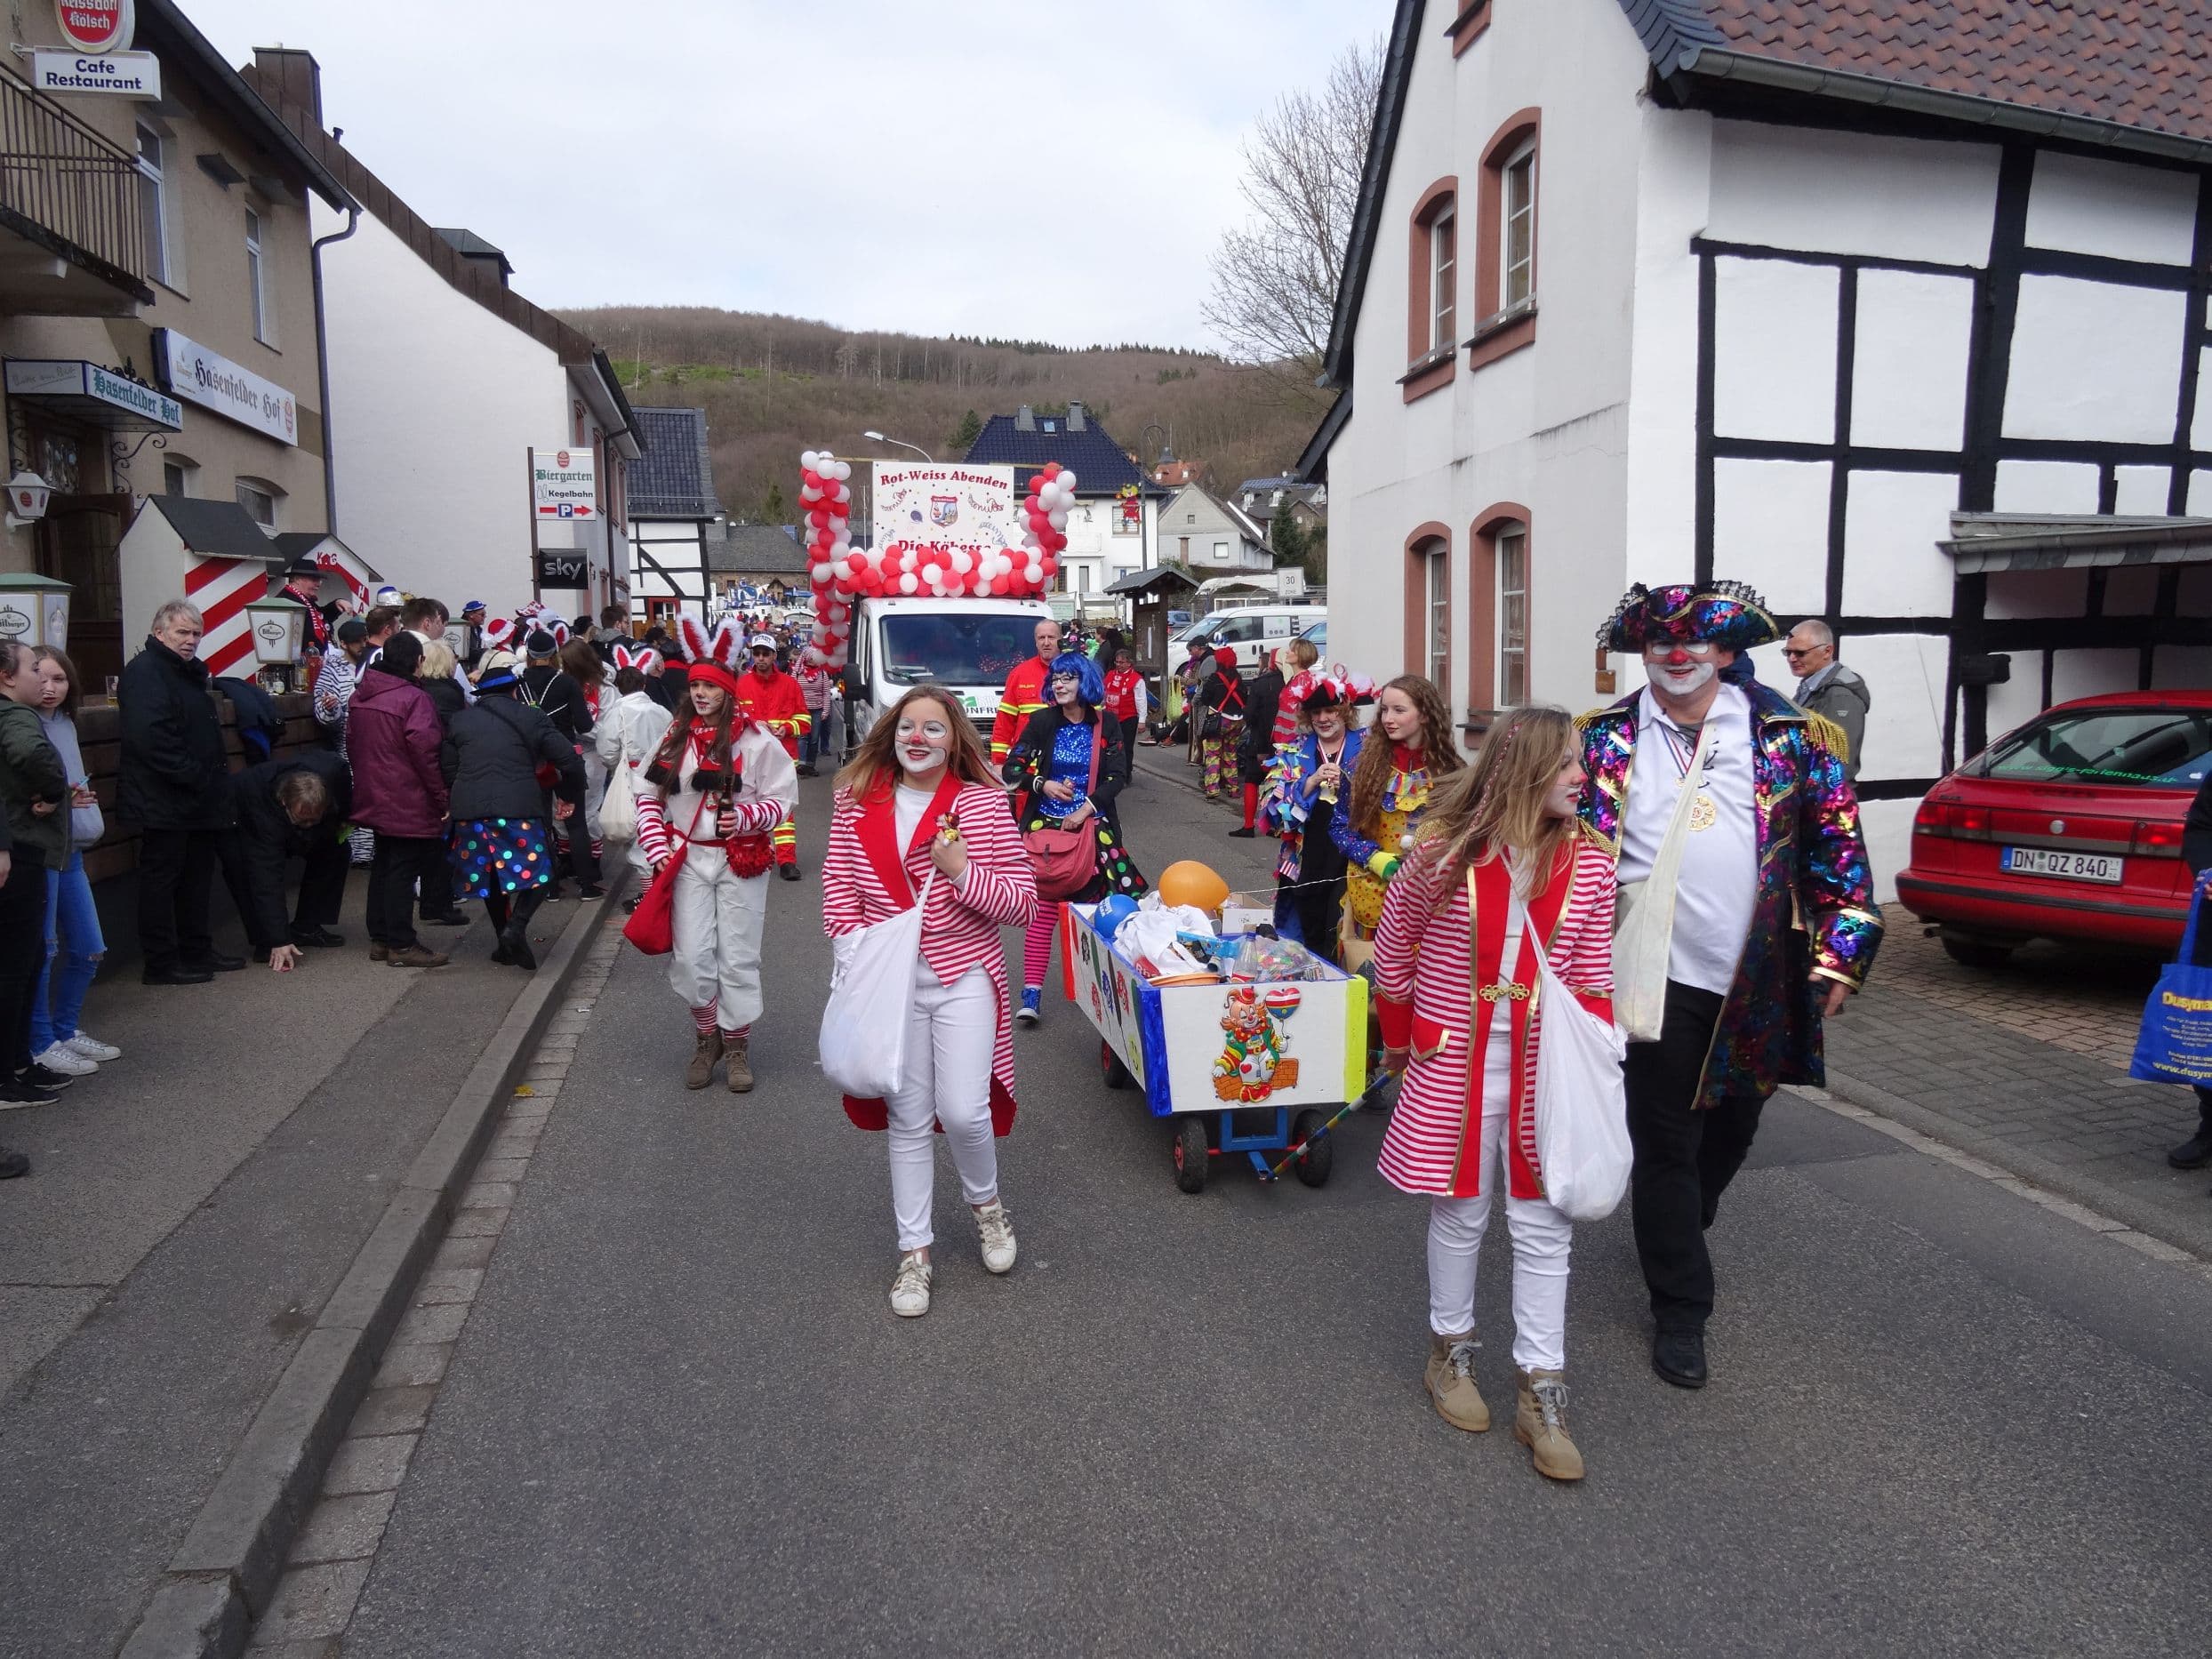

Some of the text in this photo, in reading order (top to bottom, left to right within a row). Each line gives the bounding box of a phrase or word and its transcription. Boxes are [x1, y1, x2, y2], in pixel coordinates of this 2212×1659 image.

[69, 11, 110, 30] Kölsch
[76, 59, 116, 74] Cafe
[46, 72, 142, 90] Restaurant
[93, 368, 157, 414] Hasenfelder
[160, 397, 180, 423] Hof
[195, 357, 258, 410] Hasenfelder
[262, 393, 281, 427] Hof
[535, 469, 593, 483] Biergarten
[879, 469, 1009, 490] Rot-Weiss Abenden
[548, 489, 594, 500] Kegelbahn
[560, 504, 572, 517] P
[544, 557, 582, 581] sky
[1286, 575, 1295, 585] 30
[2013, 850, 2035, 870] DN
[2048, 854, 2071, 873] QZ
[2074, 857, 2108, 877] 840
